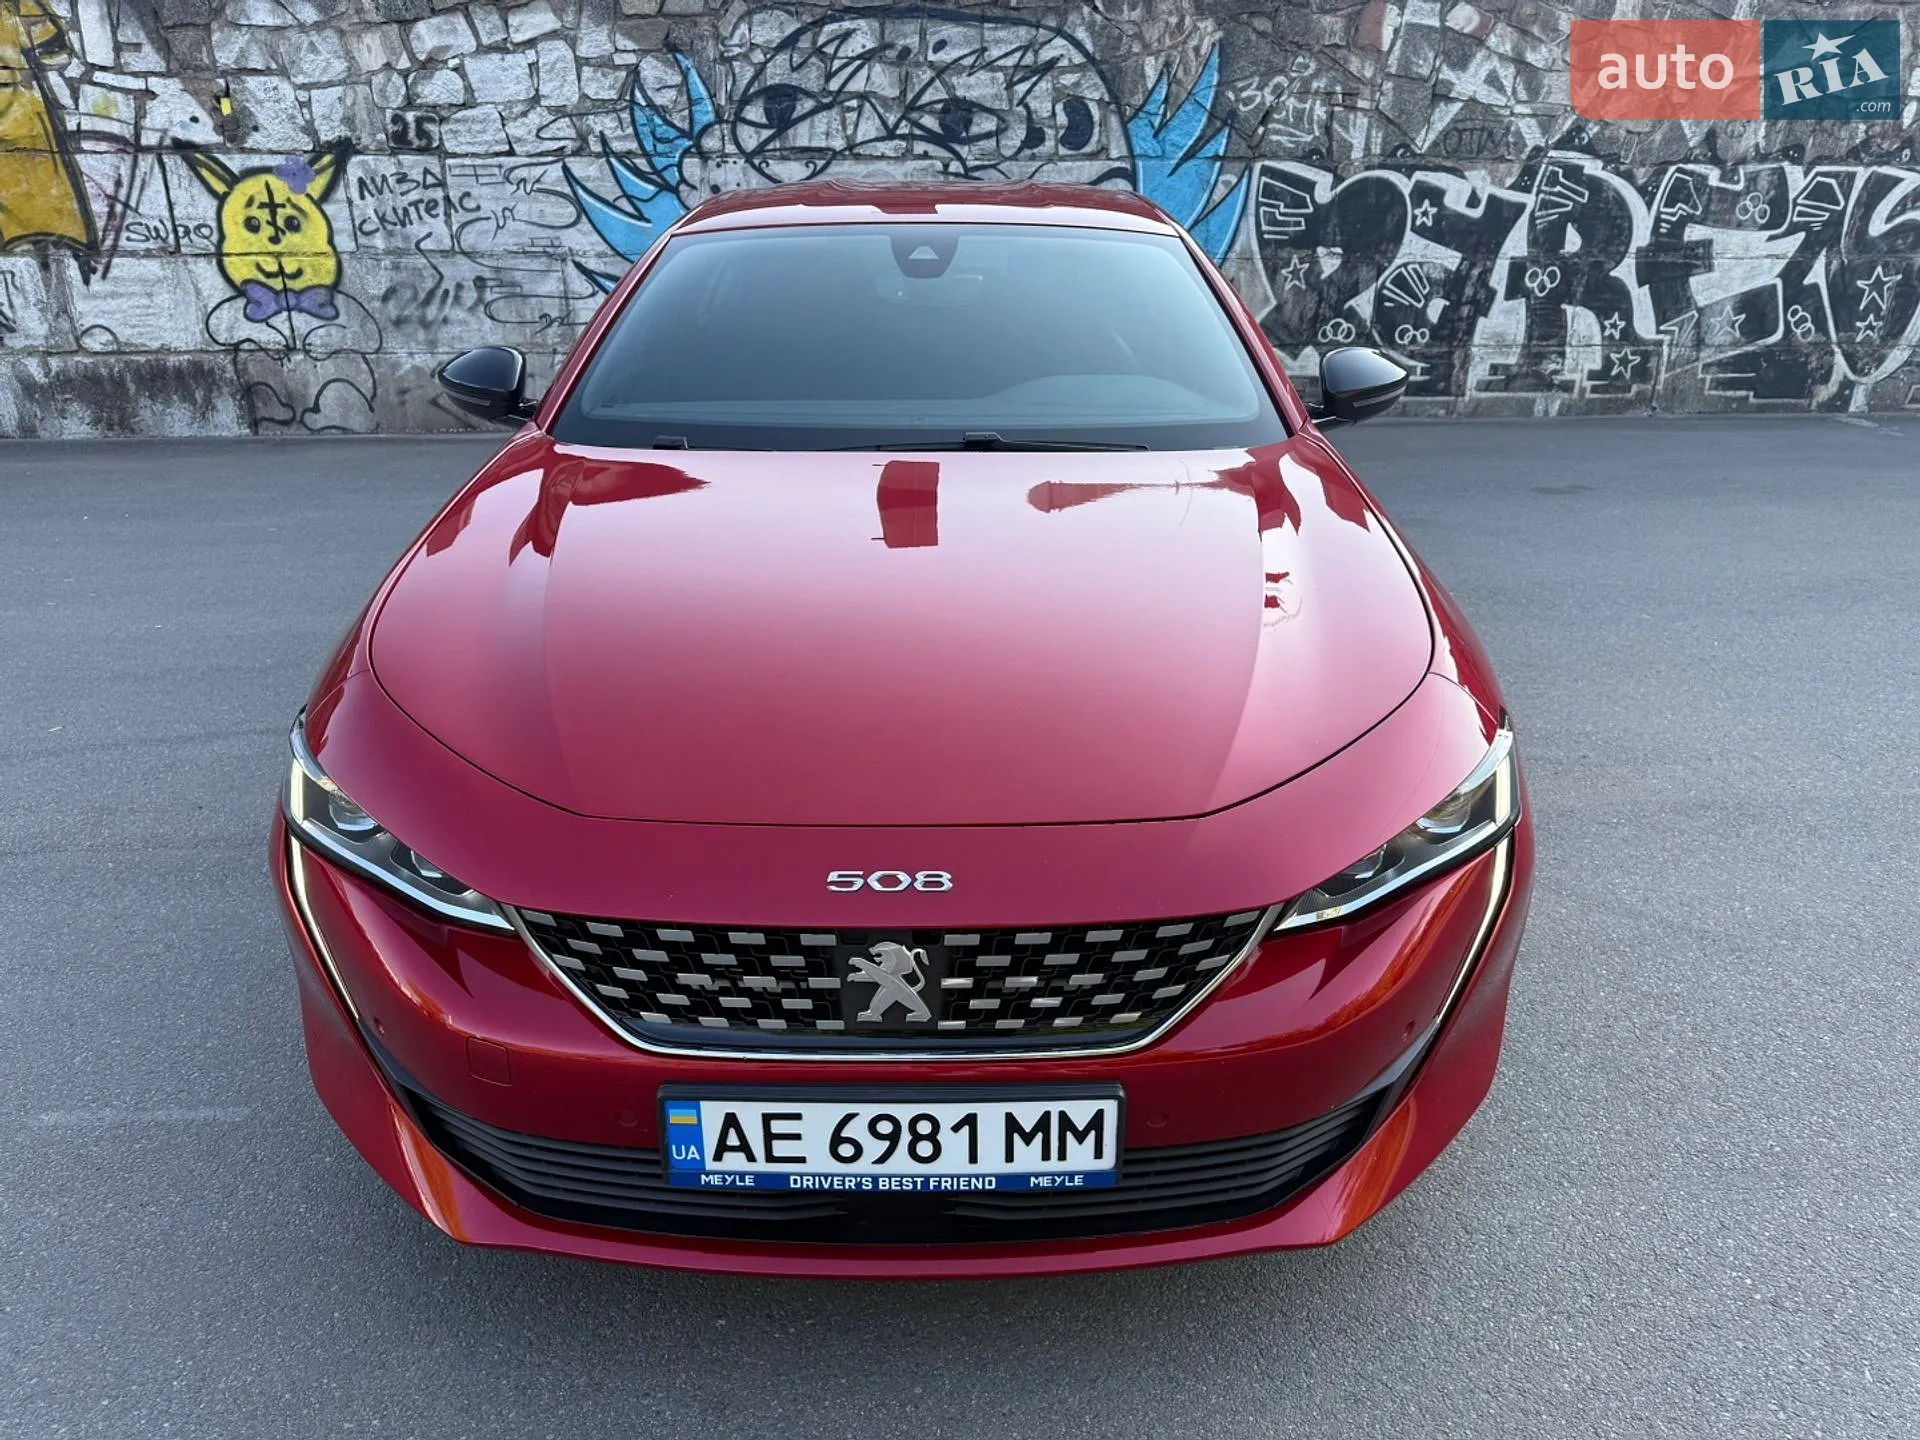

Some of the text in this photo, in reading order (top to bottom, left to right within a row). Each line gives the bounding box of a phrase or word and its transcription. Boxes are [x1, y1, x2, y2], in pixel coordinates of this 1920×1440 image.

[826, 870, 953, 893] 508
[712, 1108, 1105, 1165] AE 6981 MM
[671, 1144, 701, 1161] UA
[700, 1174, 756, 1187] MEYLE
[789, 1175, 997, 1191] DRIVER'S BEST FRIEND
[1029, 1174, 1085, 1188] MEYLE
